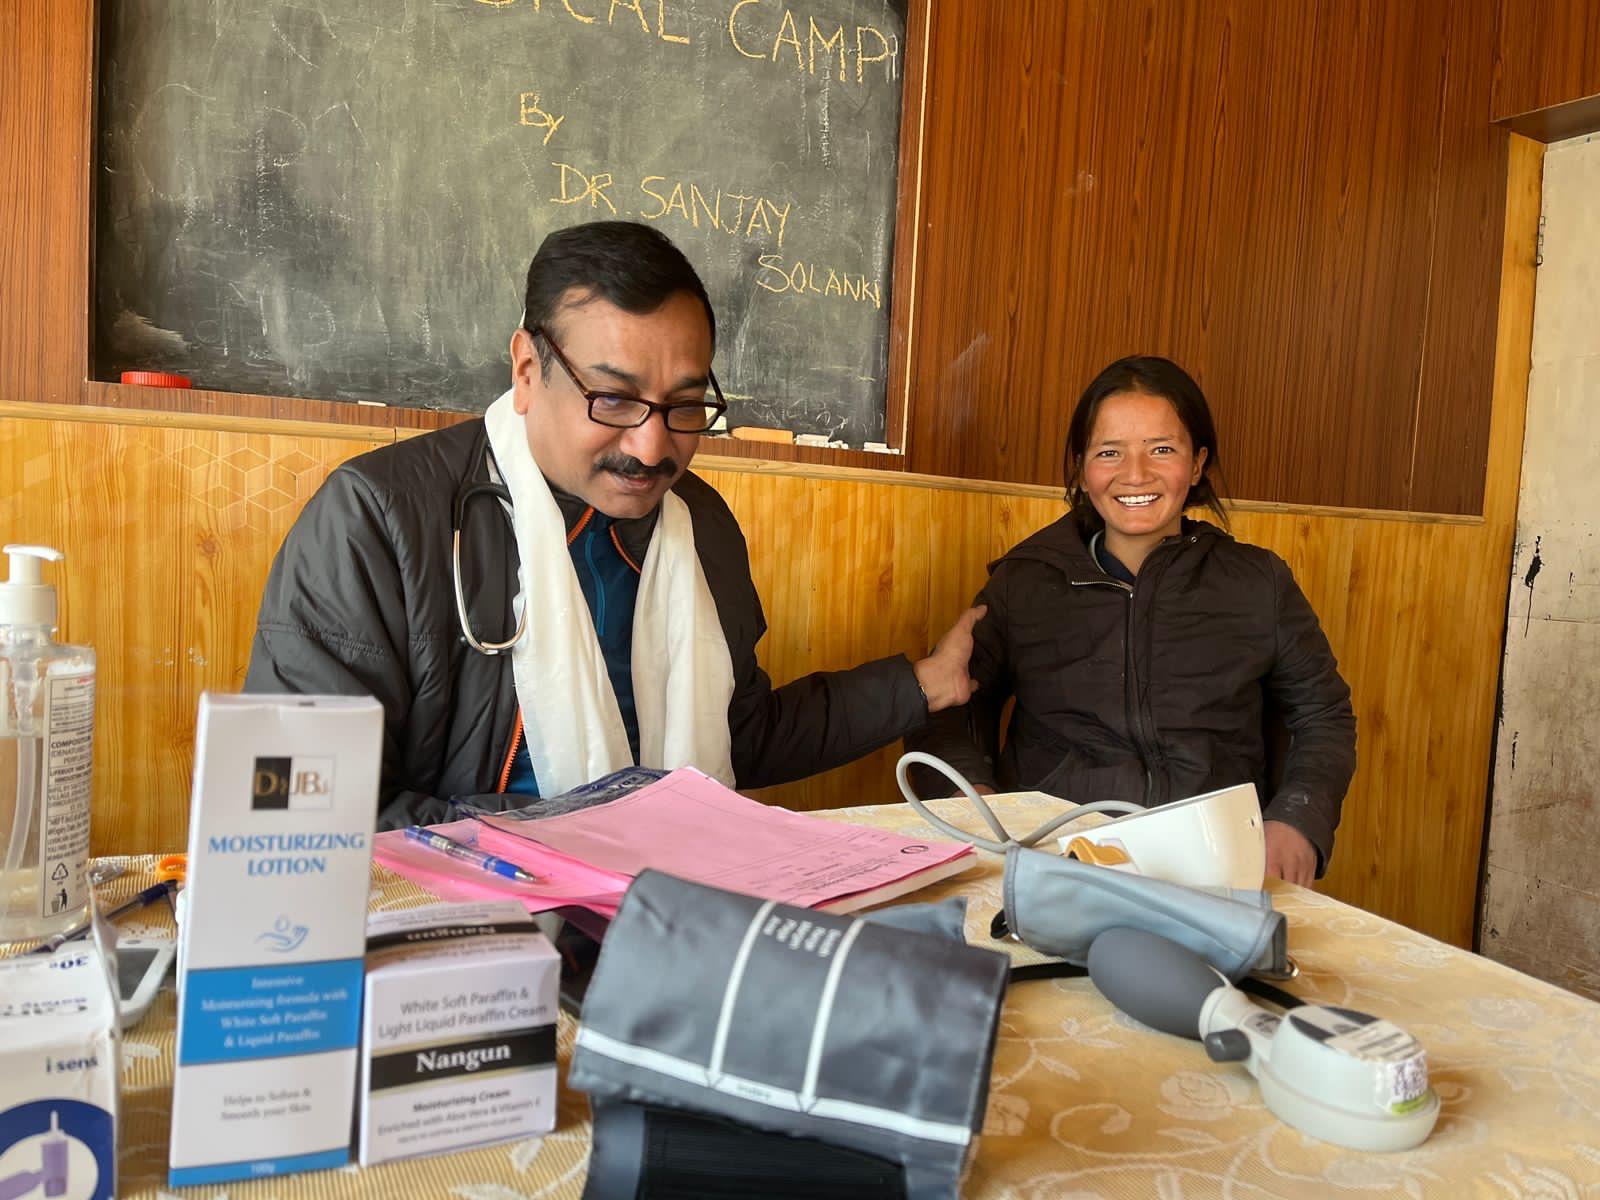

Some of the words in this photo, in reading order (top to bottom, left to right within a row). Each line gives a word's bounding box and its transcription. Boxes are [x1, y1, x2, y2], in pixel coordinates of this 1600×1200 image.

[728, 0, 890, 82] CAMP
[639, 175, 792, 247] SANJAY
[755, 253, 881, 310] SOLANKI
[207, 832, 367, 855] MOISTURIZING
[247, 857, 327, 877] LOTION
[400, 1000, 440, 1016] White
[442, 994, 467, 1010] Soft
[470, 987, 517, 1007] Paraffin
[519, 986, 529, 999] &
[378, 1021, 412, 1040] Light
[416, 1014, 457, 1034] Liquid
[459, 1007, 506, 1026] Paraffin
[508, 1003, 548, 1019] Cream
[416, 1044, 511, 1073] Nangun
